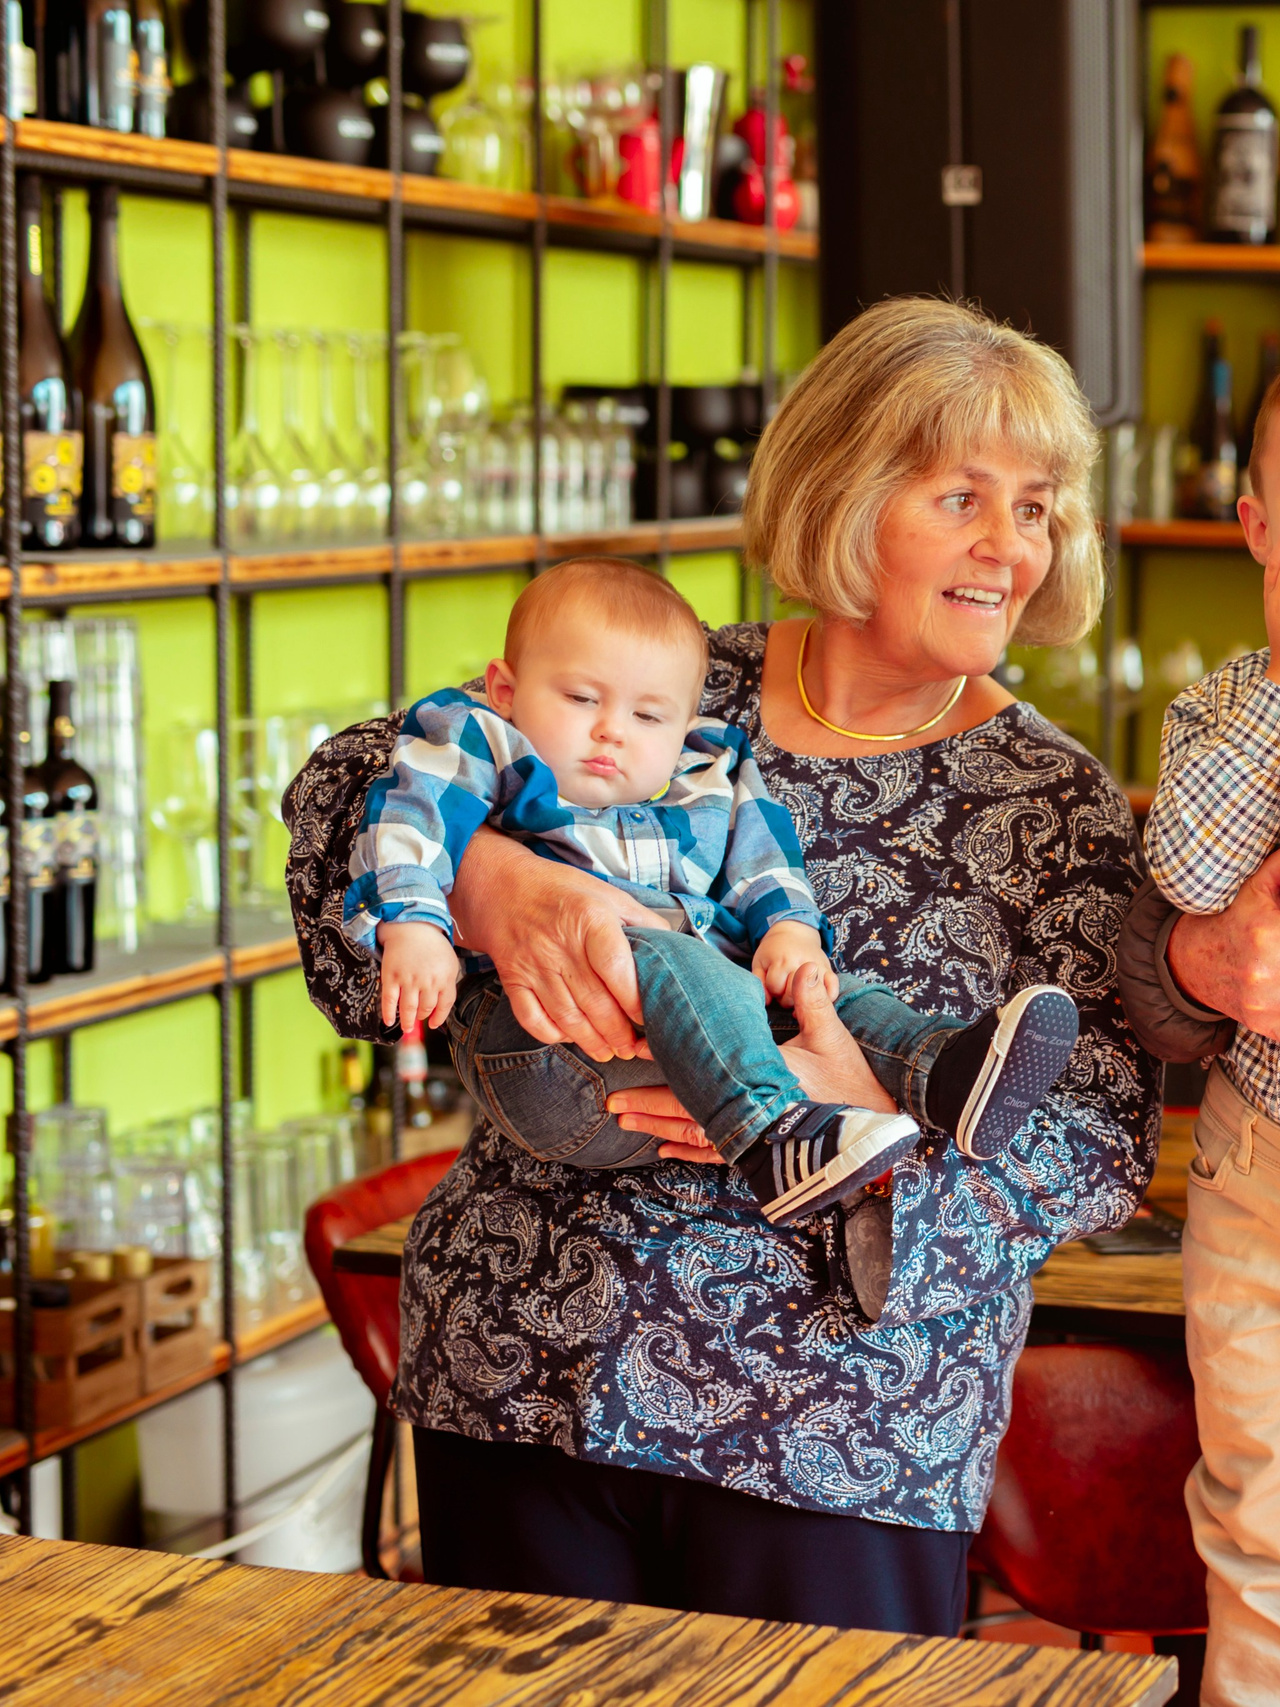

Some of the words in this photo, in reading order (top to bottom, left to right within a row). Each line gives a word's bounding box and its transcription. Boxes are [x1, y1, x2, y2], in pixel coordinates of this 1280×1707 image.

[1023, 1028, 1049, 1043] Flex
[1048, 1035, 1072, 1047] Zone
[1003, 1095, 1030, 1109] Chicco
